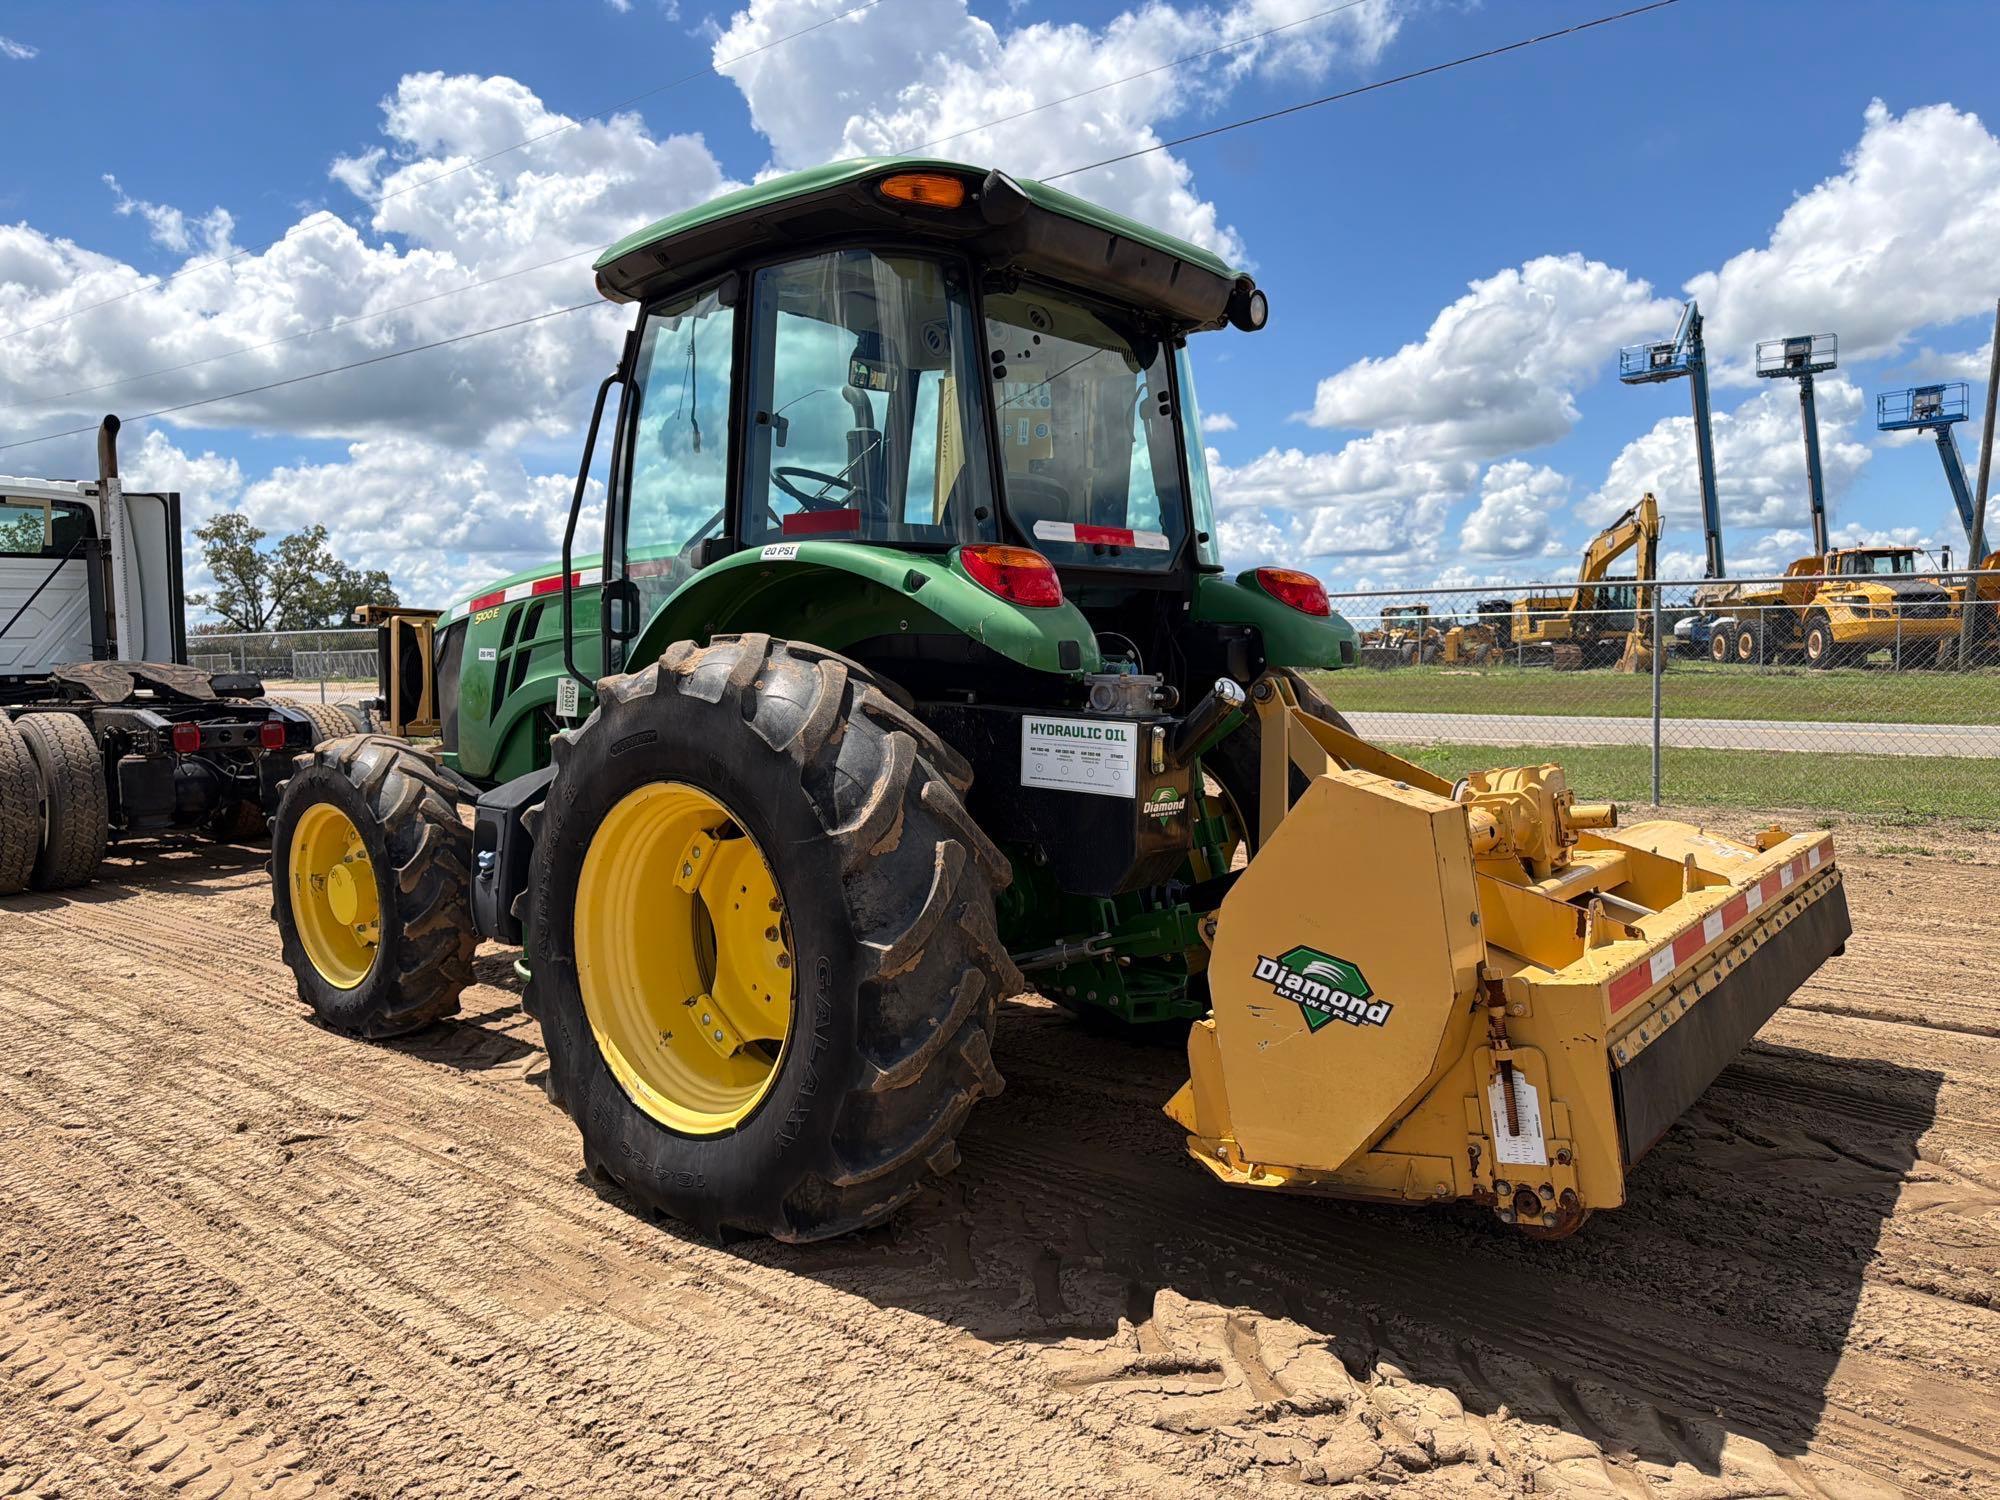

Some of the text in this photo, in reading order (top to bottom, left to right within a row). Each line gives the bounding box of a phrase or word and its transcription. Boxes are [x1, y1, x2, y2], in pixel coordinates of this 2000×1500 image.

[764, 546, 795, 556] 20 PSI
[564, 685, 576, 712] 225337
[1030, 722, 1127, 742] HYDRAULIC OIL
[1143, 797, 1186, 814] Diamond
[1255, 957, 1391, 1024] Diamond
[1276, 987, 1359, 1024] MOWERS
[775, 955, 833, 1159] GALAXY
